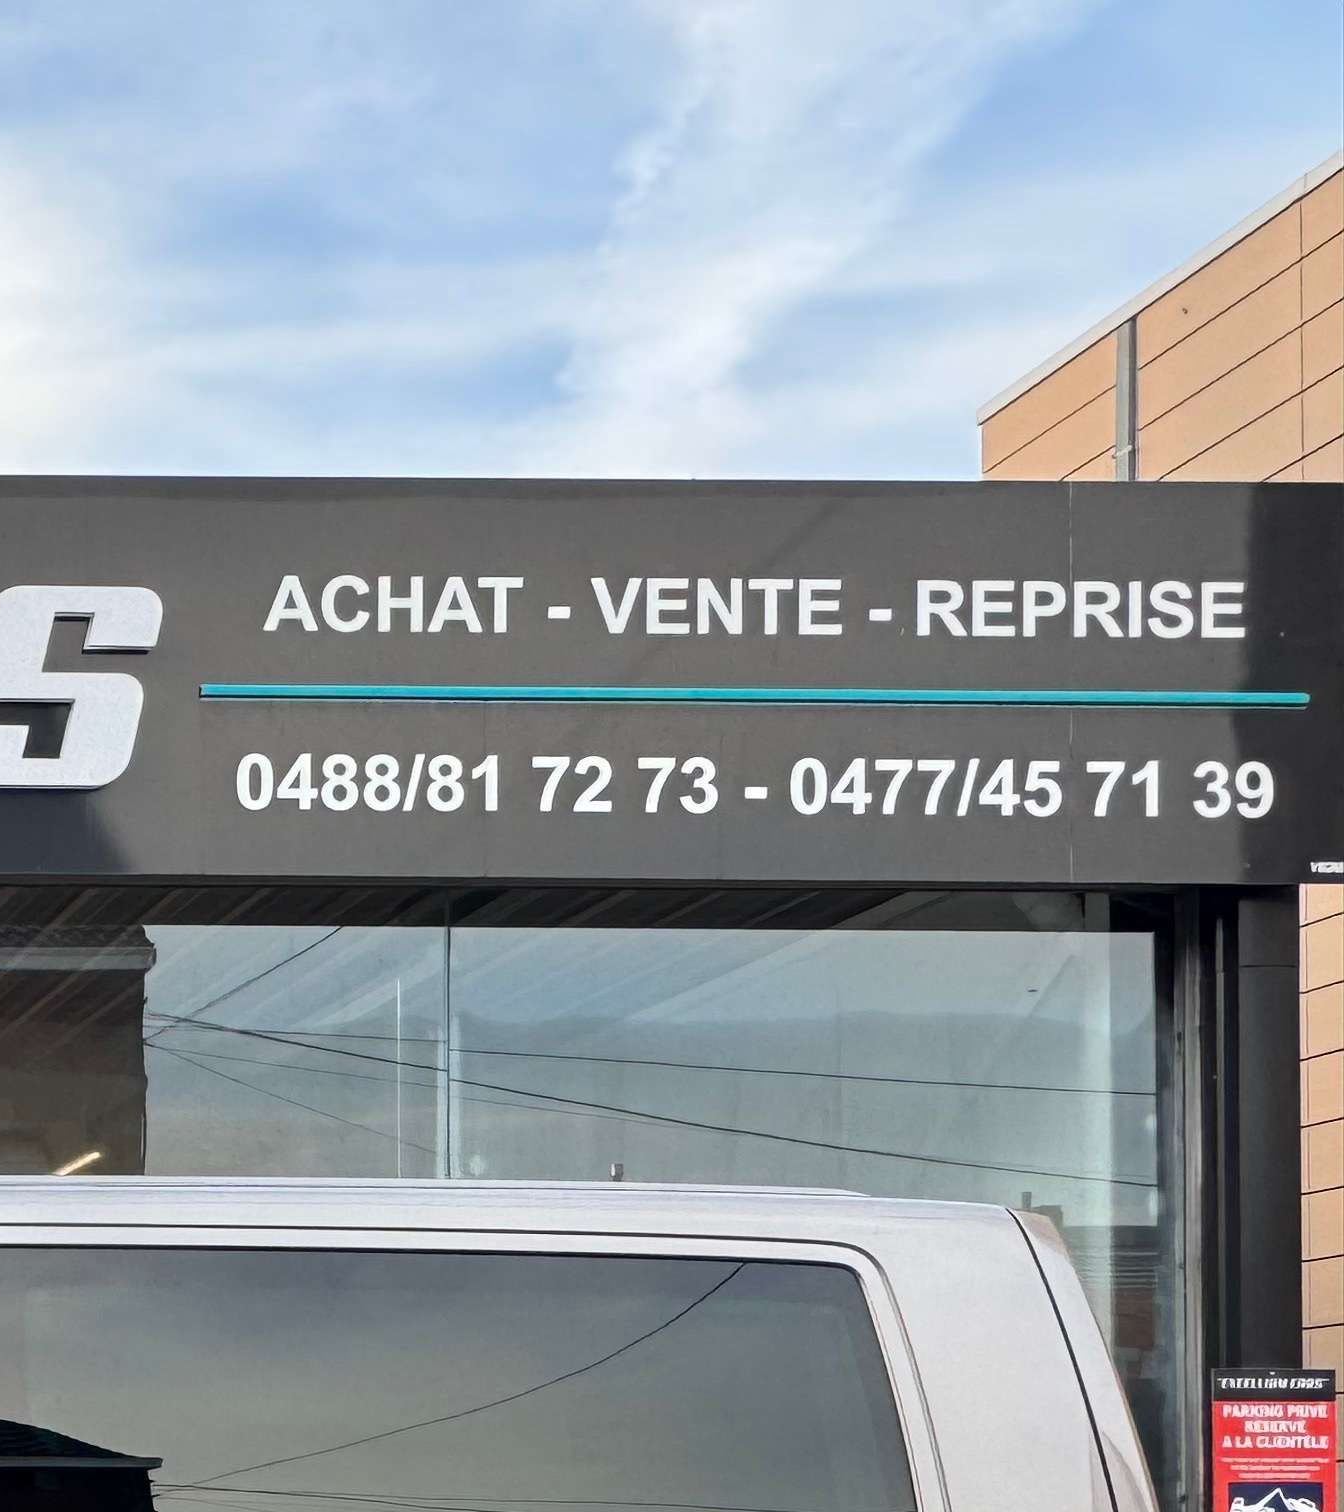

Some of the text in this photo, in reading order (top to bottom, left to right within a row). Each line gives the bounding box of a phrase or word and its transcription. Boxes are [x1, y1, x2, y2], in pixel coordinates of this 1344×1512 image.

[263, 575, 1245, 638] ACHAT - VENTE - REPRISE
[237, 753, 1274, 818] 0488/81 72 73 - 0477/45 71 39
[1223, 1404, 1284, 1417] PARKING
[1235, 1436, 1254, 1449] LA
